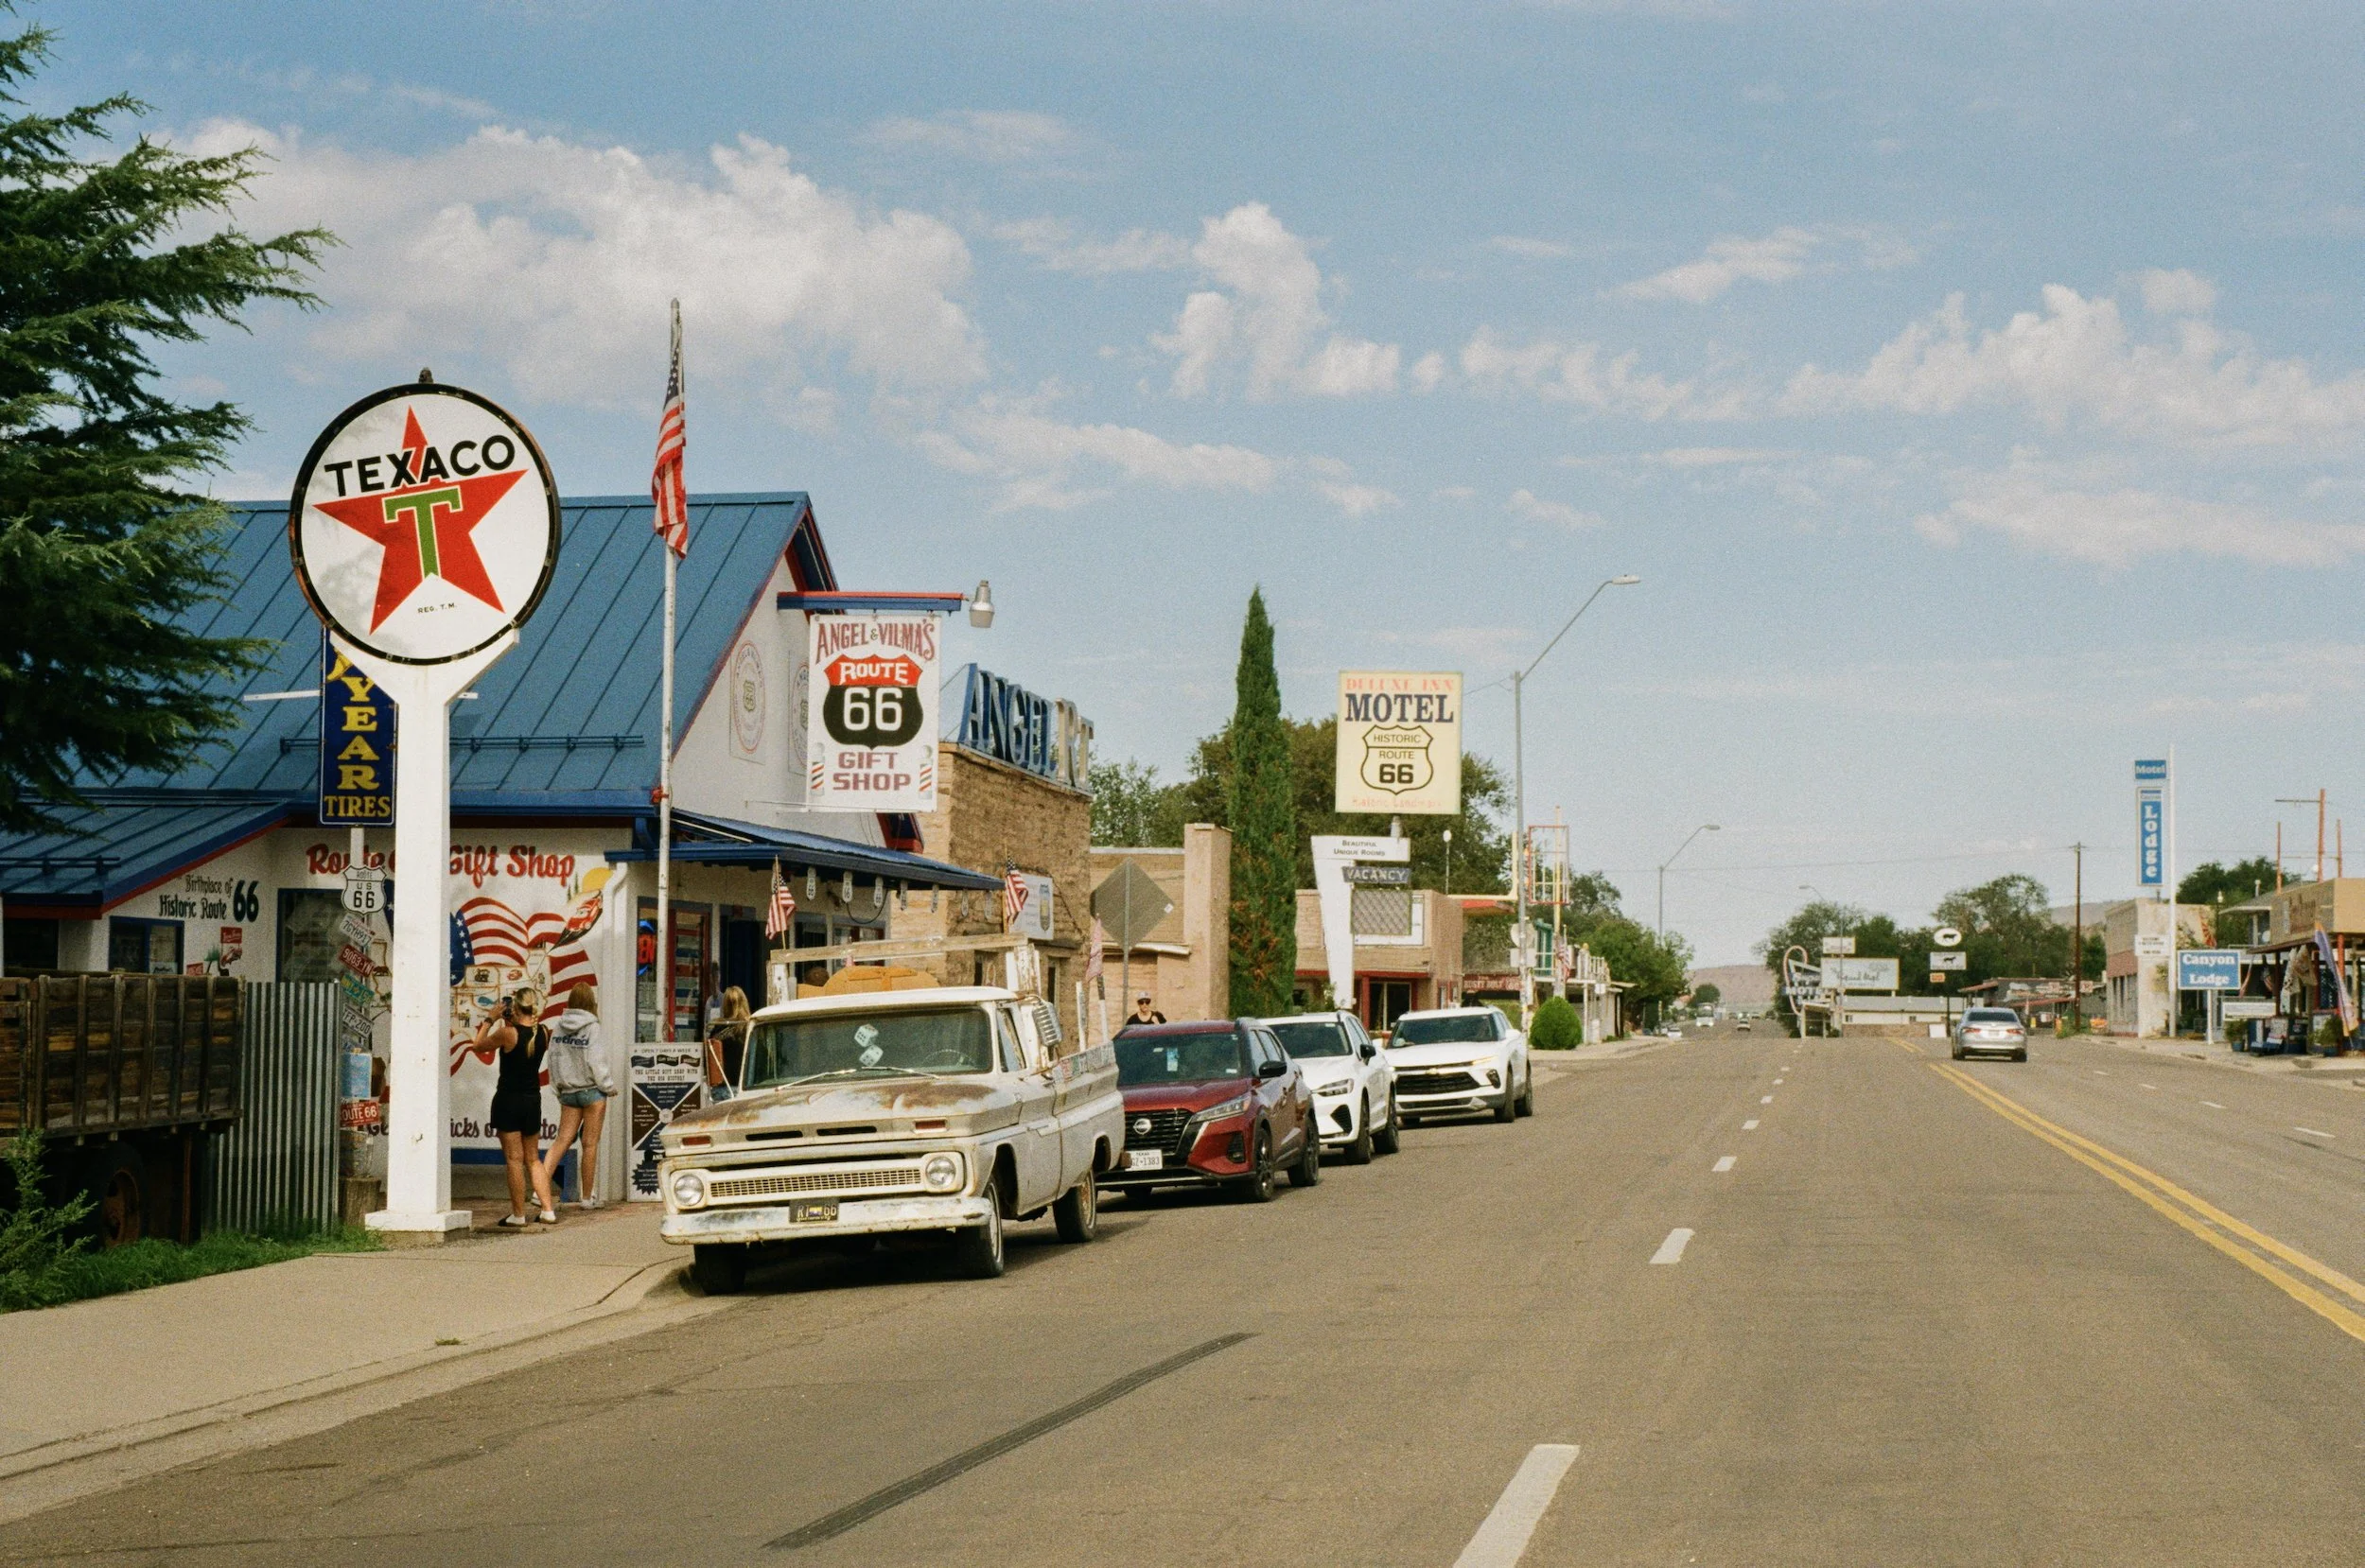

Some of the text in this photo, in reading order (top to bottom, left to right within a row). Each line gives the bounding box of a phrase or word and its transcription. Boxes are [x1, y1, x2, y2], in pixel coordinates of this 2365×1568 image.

[324, 434, 517, 497] TEXACO
[382, 486, 463, 580] T
[815, 618, 936, 665] ANGEL & VILMA'S
[838, 662, 908, 685] ROUTE
[843, 687, 902, 731] 66
[1345, 693, 1454, 723] MOTEL
[957, 663, 1059, 779] ANGEL
[1373, 734, 1422, 743] HISTORIC
[837, 752, 898, 770] GIFT
[1378, 750, 1415, 759] ROUTE
[1379, 763, 1414, 784] 66
[2135, 764, 2165, 774] Motel
[832, 773, 911, 791] SHOP
[324, 795, 392, 818] TIRES
[2145, 805, 2158, 878] Lodge
[307, 843, 386, 874] Rote
[449, 845, 499, 889] Gift
[506, 845, 575, 887] Shop
[356, 871, 373, 880] ROUTE
[1346, 869, 1407, 880] VACANCY
[184, 874, 235, 898] Birthplace of
[158, 880, 260, 923] Historic Route 66
[353, 891, 375, 909] 66
[2182, 953, 2235, 968] Canyon
[2189, 973, 2231, 985] Lodge
[342, 1105, 377, 1122] OUTE 66
[450, 1118, 480, 1139] icks
[823, 1204, 837, 1216] 66
